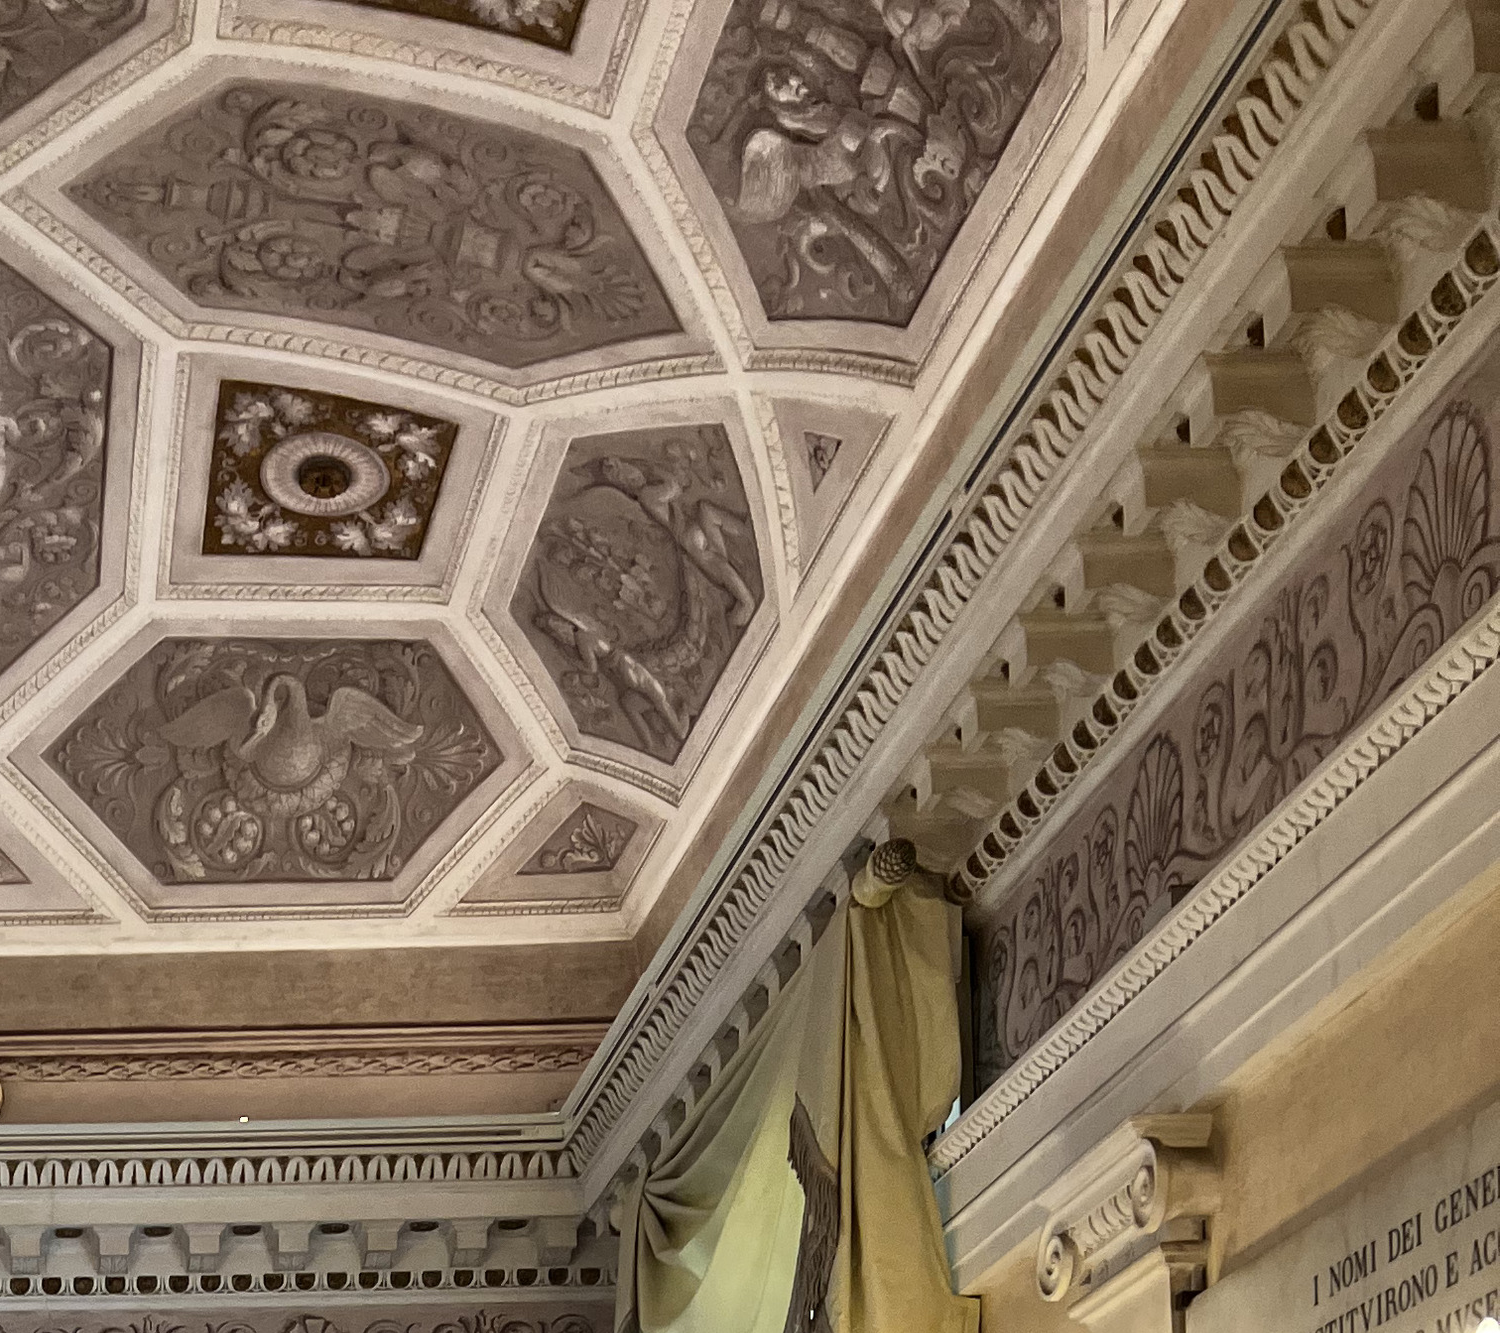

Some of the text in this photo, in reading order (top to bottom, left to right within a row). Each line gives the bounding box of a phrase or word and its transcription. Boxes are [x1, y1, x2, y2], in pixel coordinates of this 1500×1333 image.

[1313, 1274, 1320, 1306] I
[1329, 1240, 1377, 1298] NOMI
[1388, 1212, 1422, 1264] DEI
[1446, 1251, 1459, 1288] E
[1470, 1230, 1500, 1277] AC
